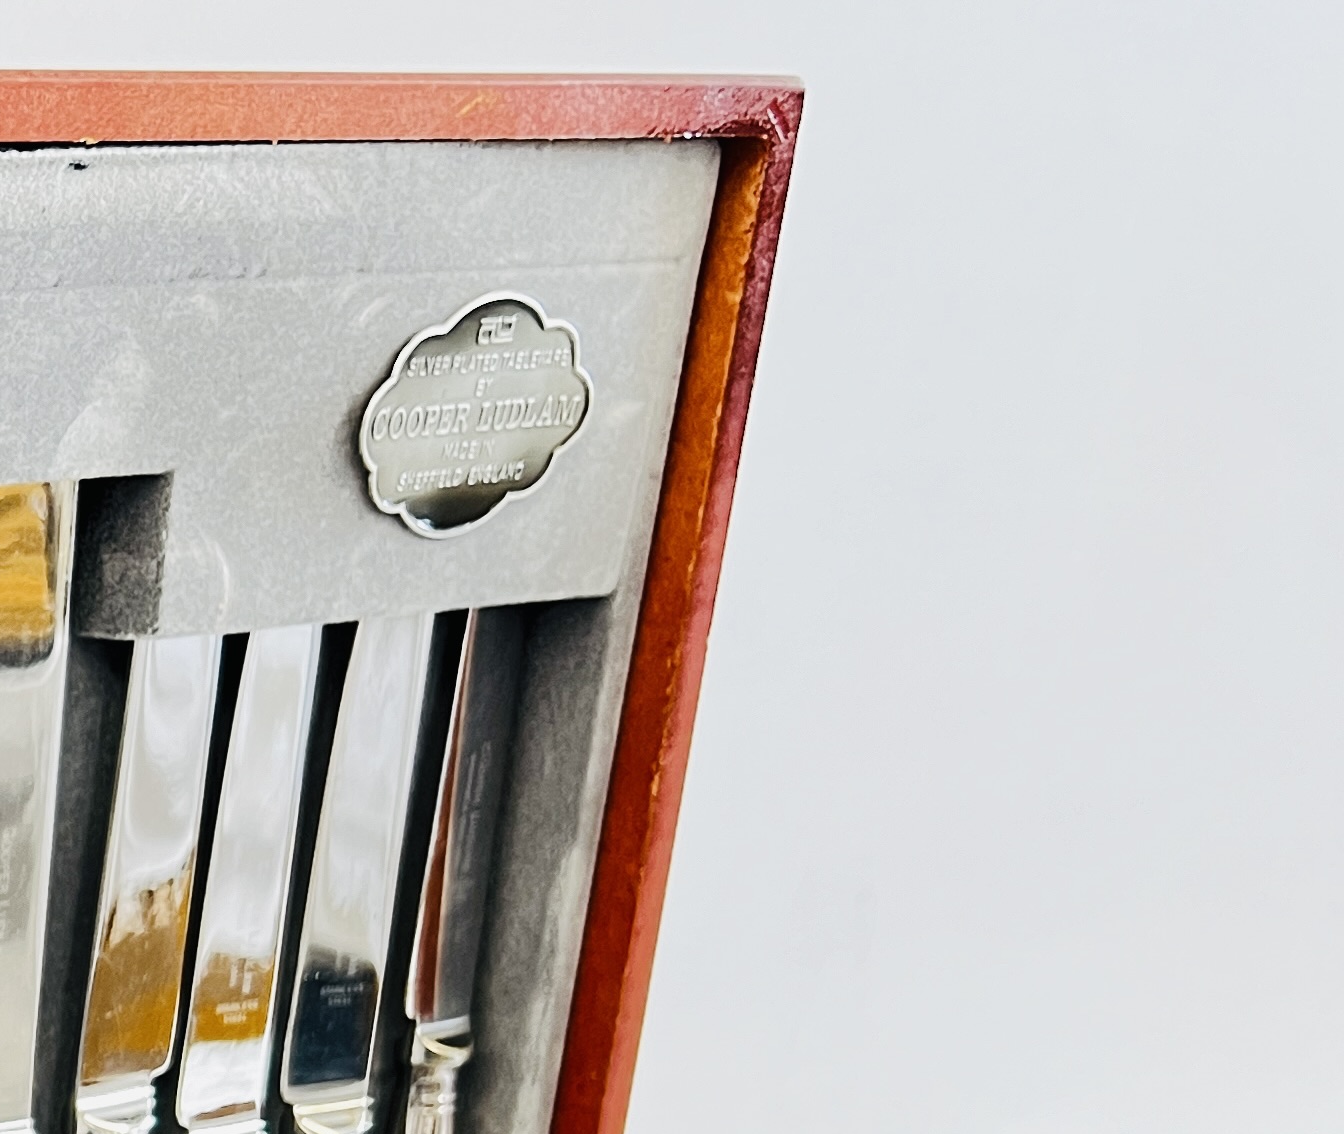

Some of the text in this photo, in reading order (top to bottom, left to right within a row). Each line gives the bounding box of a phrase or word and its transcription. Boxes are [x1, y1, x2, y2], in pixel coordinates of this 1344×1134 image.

[475, 377, 494, 397] BY
[371, 395, 582, 441] COOPER LUDLAM
[443, 440, 478, 460] MADE
[396, 459, 525, 492] SHEFFIELD ENGLAND
